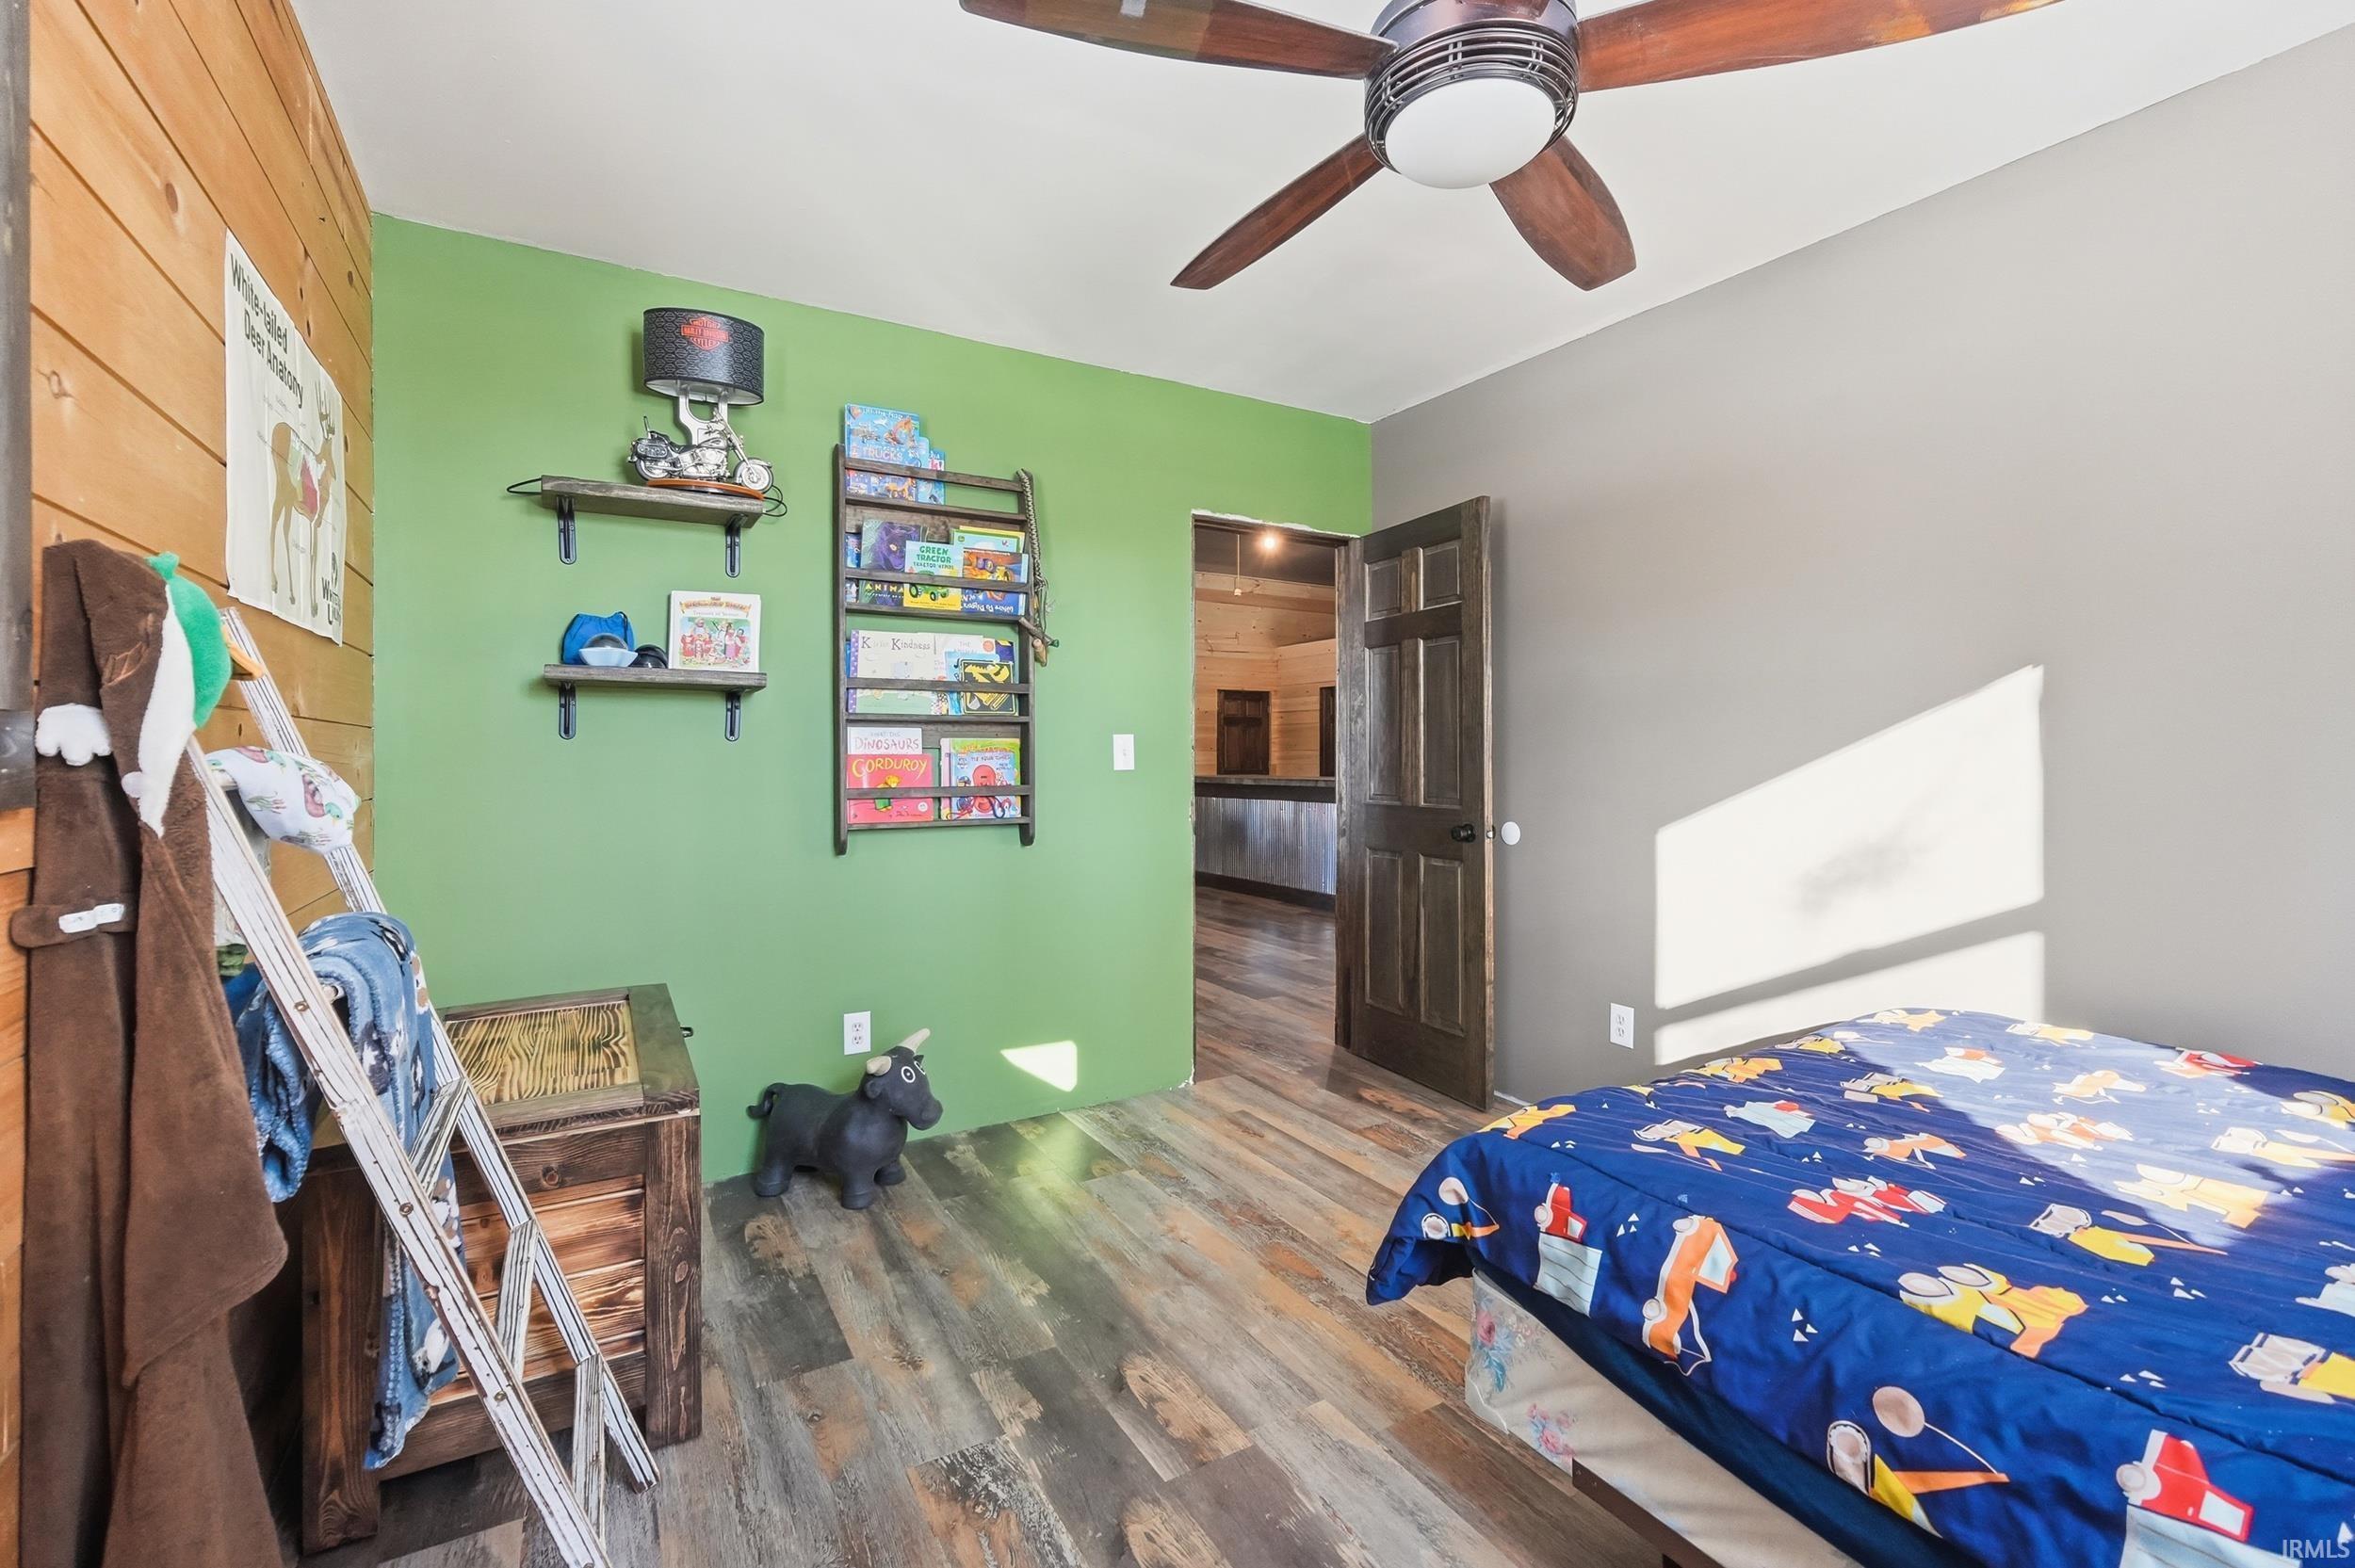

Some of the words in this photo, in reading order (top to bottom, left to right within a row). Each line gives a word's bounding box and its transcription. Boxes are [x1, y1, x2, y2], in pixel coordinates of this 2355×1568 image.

[230, 252, 288, 355] White-tailed
[244, 307, 265, 359] Deer
[267, 339, 303, 409] Anatomy
[916, 554, 951, 563] TRACTOR
[919, 545, 950, 556] GREEN
[861, 636, 872, 649] K
[890, 638, 931, 651] Kindness
[852, 757, 928, 782] CORDUROY
